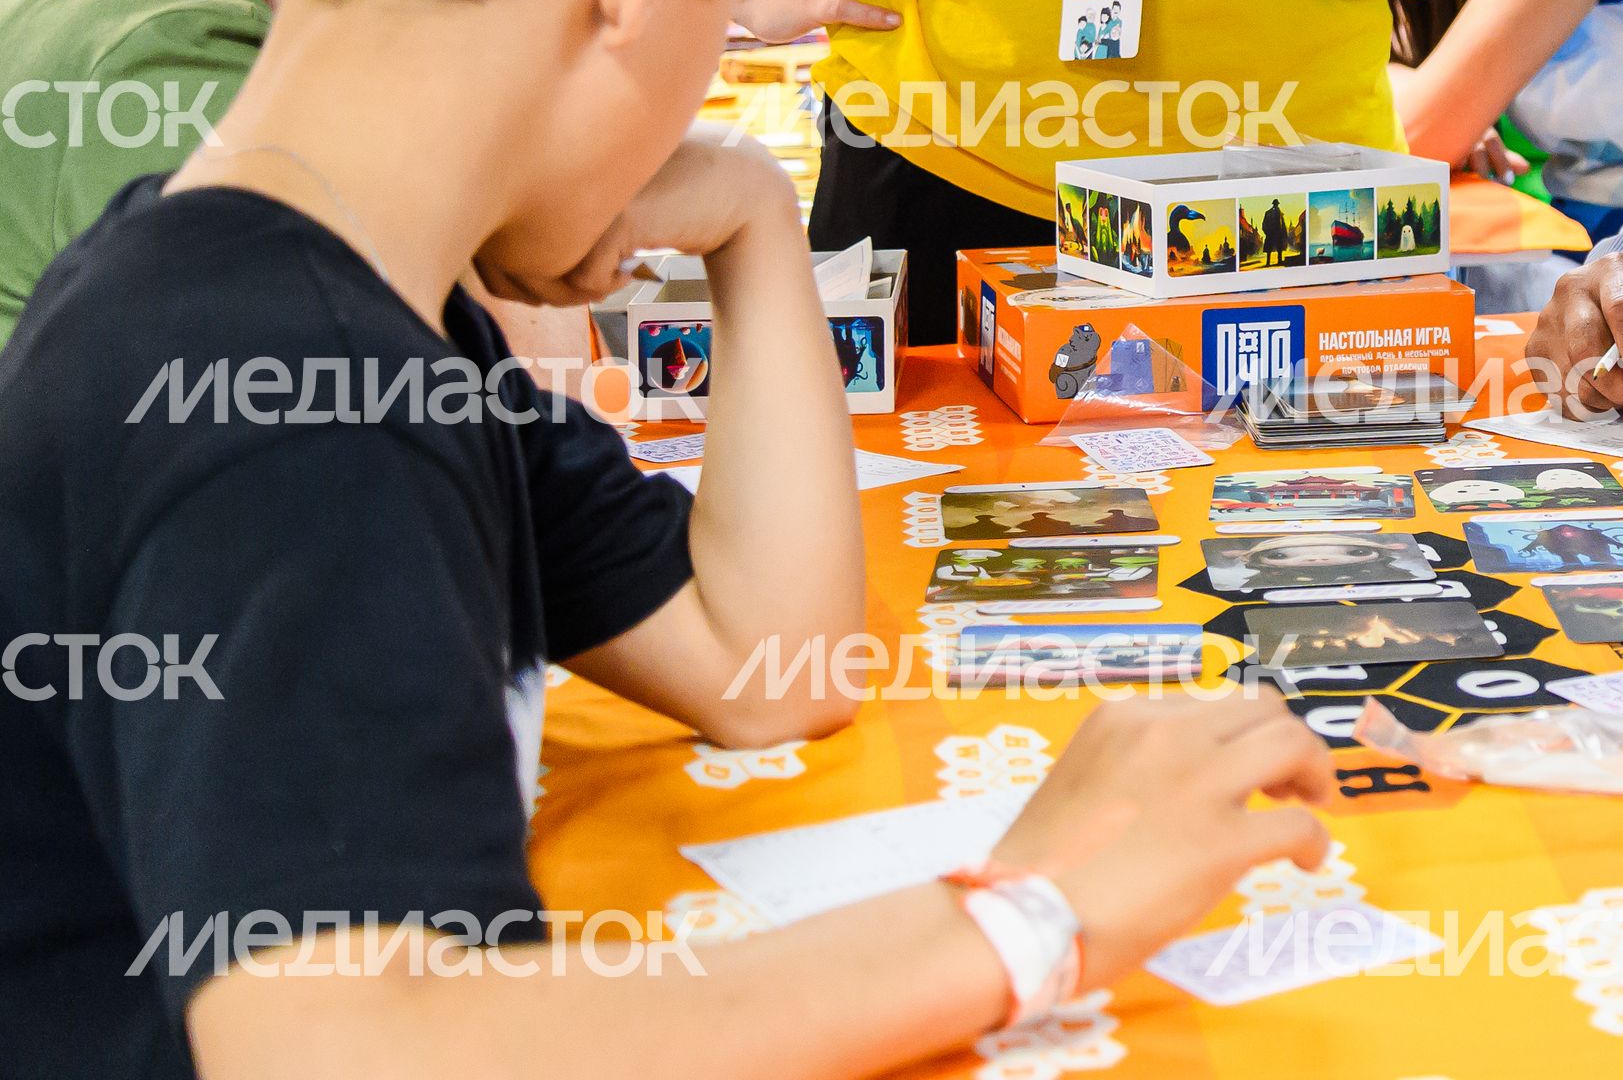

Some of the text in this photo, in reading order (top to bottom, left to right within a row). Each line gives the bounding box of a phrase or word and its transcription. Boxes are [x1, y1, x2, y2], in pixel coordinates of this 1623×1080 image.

[1319, 326, 1451, 351] НАСТОЛЬНАЯ ИГРА
[917, 496, 939, 545] WORLD
